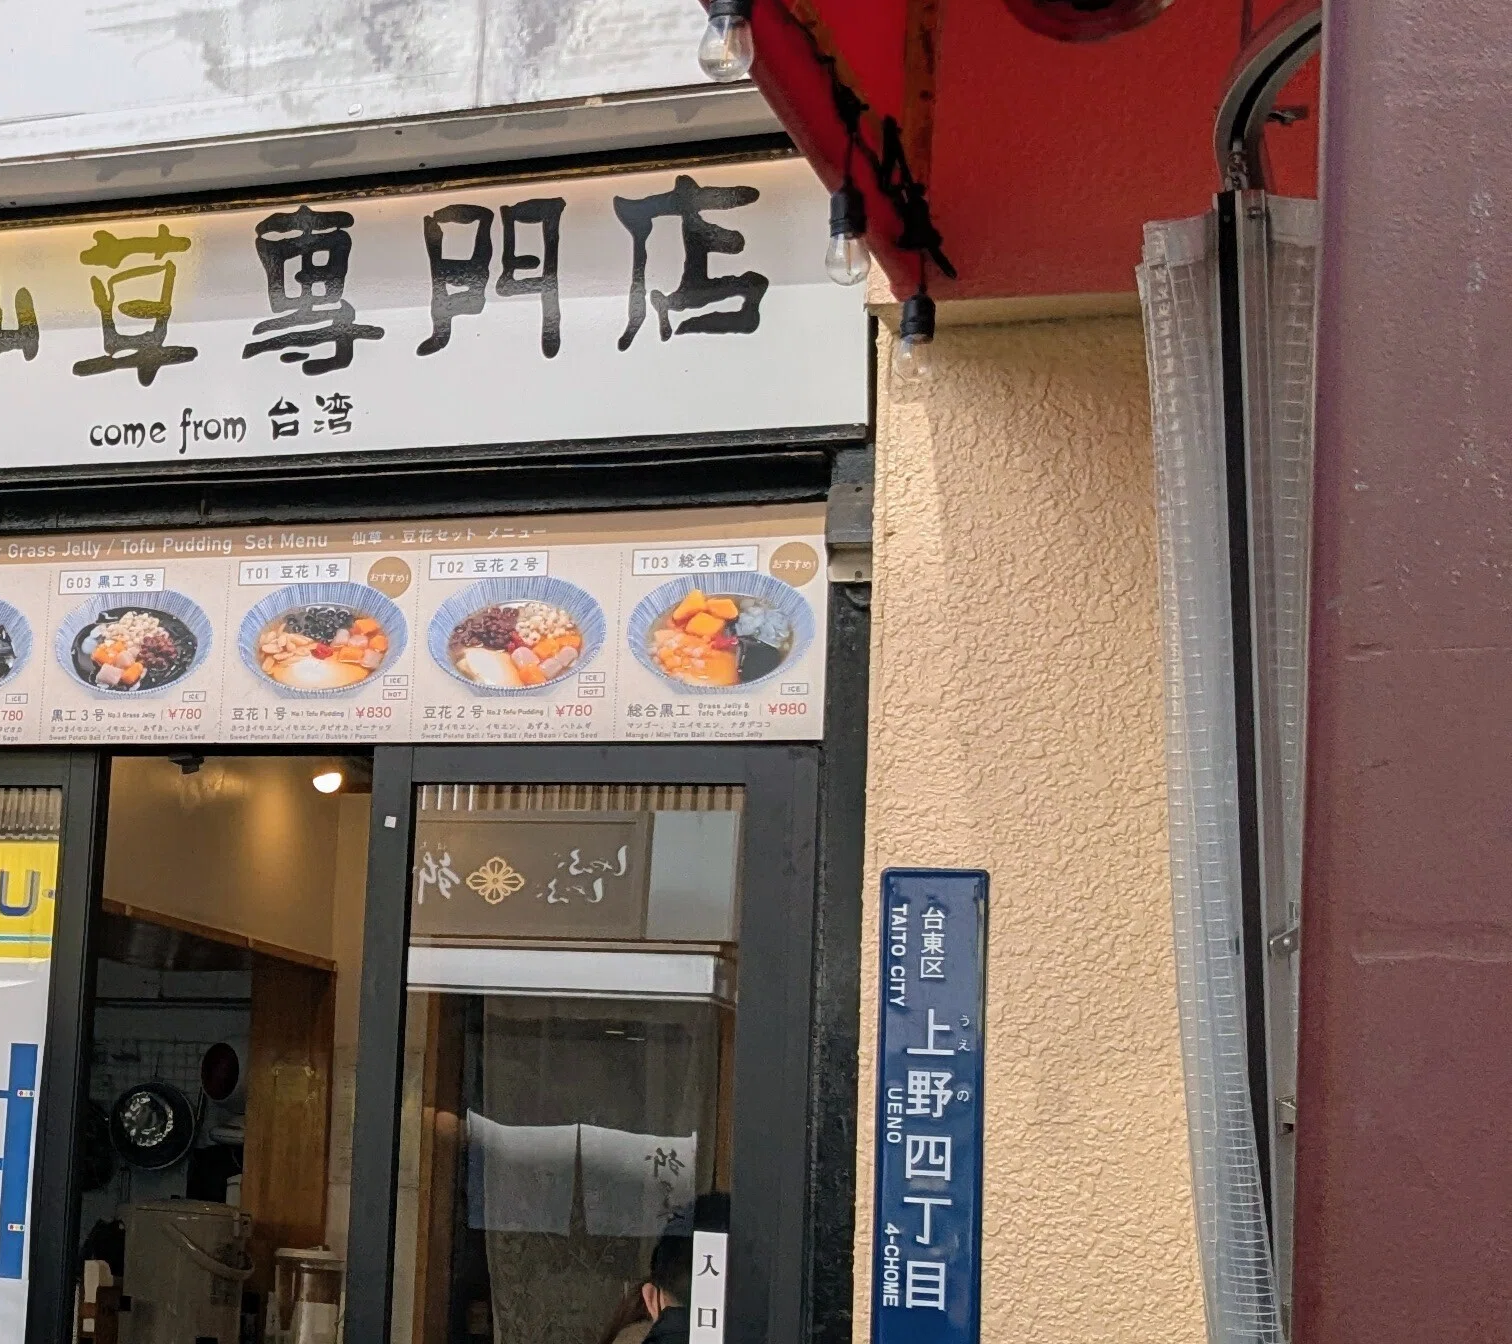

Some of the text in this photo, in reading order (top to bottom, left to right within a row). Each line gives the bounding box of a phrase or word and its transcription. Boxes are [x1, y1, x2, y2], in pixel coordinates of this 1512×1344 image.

[89, 393, 353, 454] come from 台湾
[8, 543, 56, 559] Grass
[62, 541, 101, 560] Jelly
[121, 539, 155, 555] Tofu
[163, 536, 232, 554] Pudding
[244, 534, 273, 550] Set
[280, 532, 328, 548] Menu
[487, 527, 547, 540] メニュー
[246, 568, 269, 580] T01
[437, 561, 464, 574] T02
[641, 556, 669, 569] T03
[66, 577, 91, 589] G03
[168, 708, 202, 720] ¥780
[356, 706, 392, 719] ¥830
[555, 705, 593, 717] ¥780
[767, 703, 807, 716] ¥980
[919, 906, 946, 980] 台東区
[889, 903, 907, 1007] TAITO CITY
[887, 1087, 904, 1145] UENO
[903, 1008, 955, 1312] 上野四丁目
[883, 1222, 900, 1308] 4-CHOME
[696, 1254, 720, 1329] 入口
